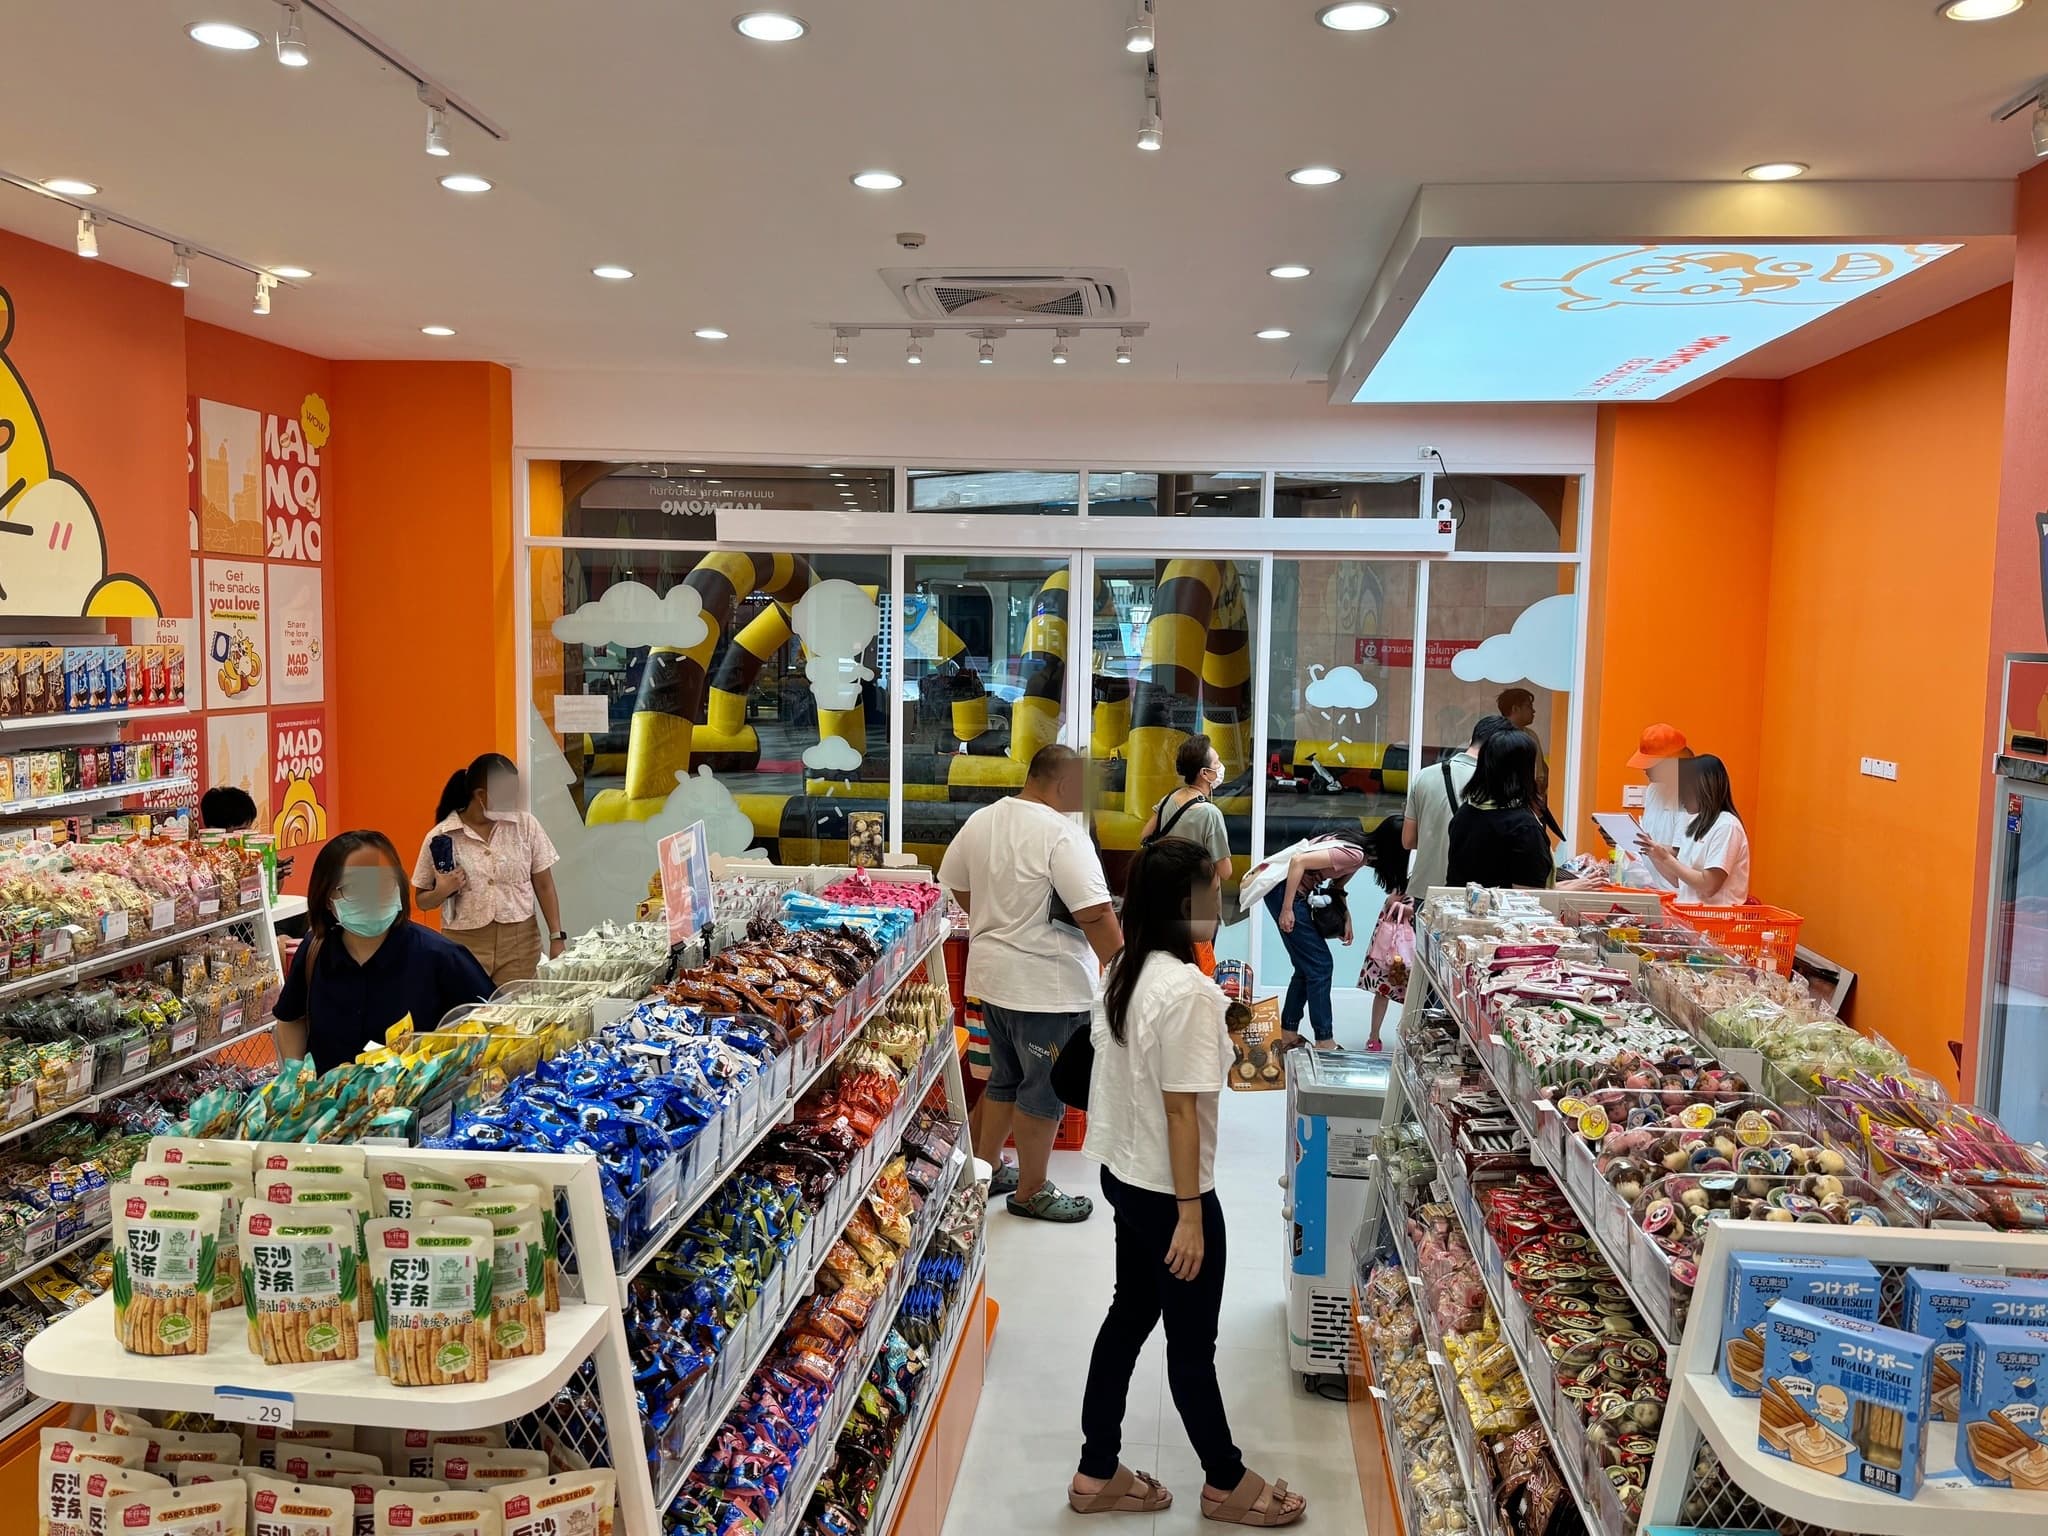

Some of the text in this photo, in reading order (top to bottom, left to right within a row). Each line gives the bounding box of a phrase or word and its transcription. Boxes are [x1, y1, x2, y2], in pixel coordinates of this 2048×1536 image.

[306, 408, 326, 433] WOW
[225, 569, 244, 581] Get
[209, 579, 260, 594] the snacks
[209, 594, 260, 614] you love
[287, 620, 306, 629] Share
[287, 653, 308, 666] MAD
[286, 666, 309, 677] MOMO
[277, 728, 322, 760] MAD
[274, 755, 323, 783] MOMO
[202, 1182, 229, 1191] STRIPS
[302, 1192, 349, 1201] TARO STRIPS
[153, 1210, 197, 1220] TARO STRIPS
[128, 1229, 161, 1253] 反沙
[420, 1236, 468, 1247] TARO STRIPS
[254, 1246, 292, 1269] 反沙
[390, 1258, 430, 1282] 反沙
[258, 1269, 294, 1293] 芋条
[1808, 1281, 1875, 1297] つけボー
[390, 1283, 430, 1308] 芋条
[1841, 1296, 1873, 1308] BISCUIT
[1992, 1302, 2048, 1319] つけボ
[1838, 1342, 1915, 1370] つけボー
[1875, 1368, 1912, 1388] BISCUIT
[259, 1406, 282, 1423] 29
[1864, 1464, 1898, 1487] 酸奶味
[540, 1486, 593, 1507] TARO STRIPS
[163, 1504, 218, 1521] TARO STRIPS
[284, 1504, 329, 1517] TARO STRIPS
[422, 1510, 475, 1525] TARO STRIPS
